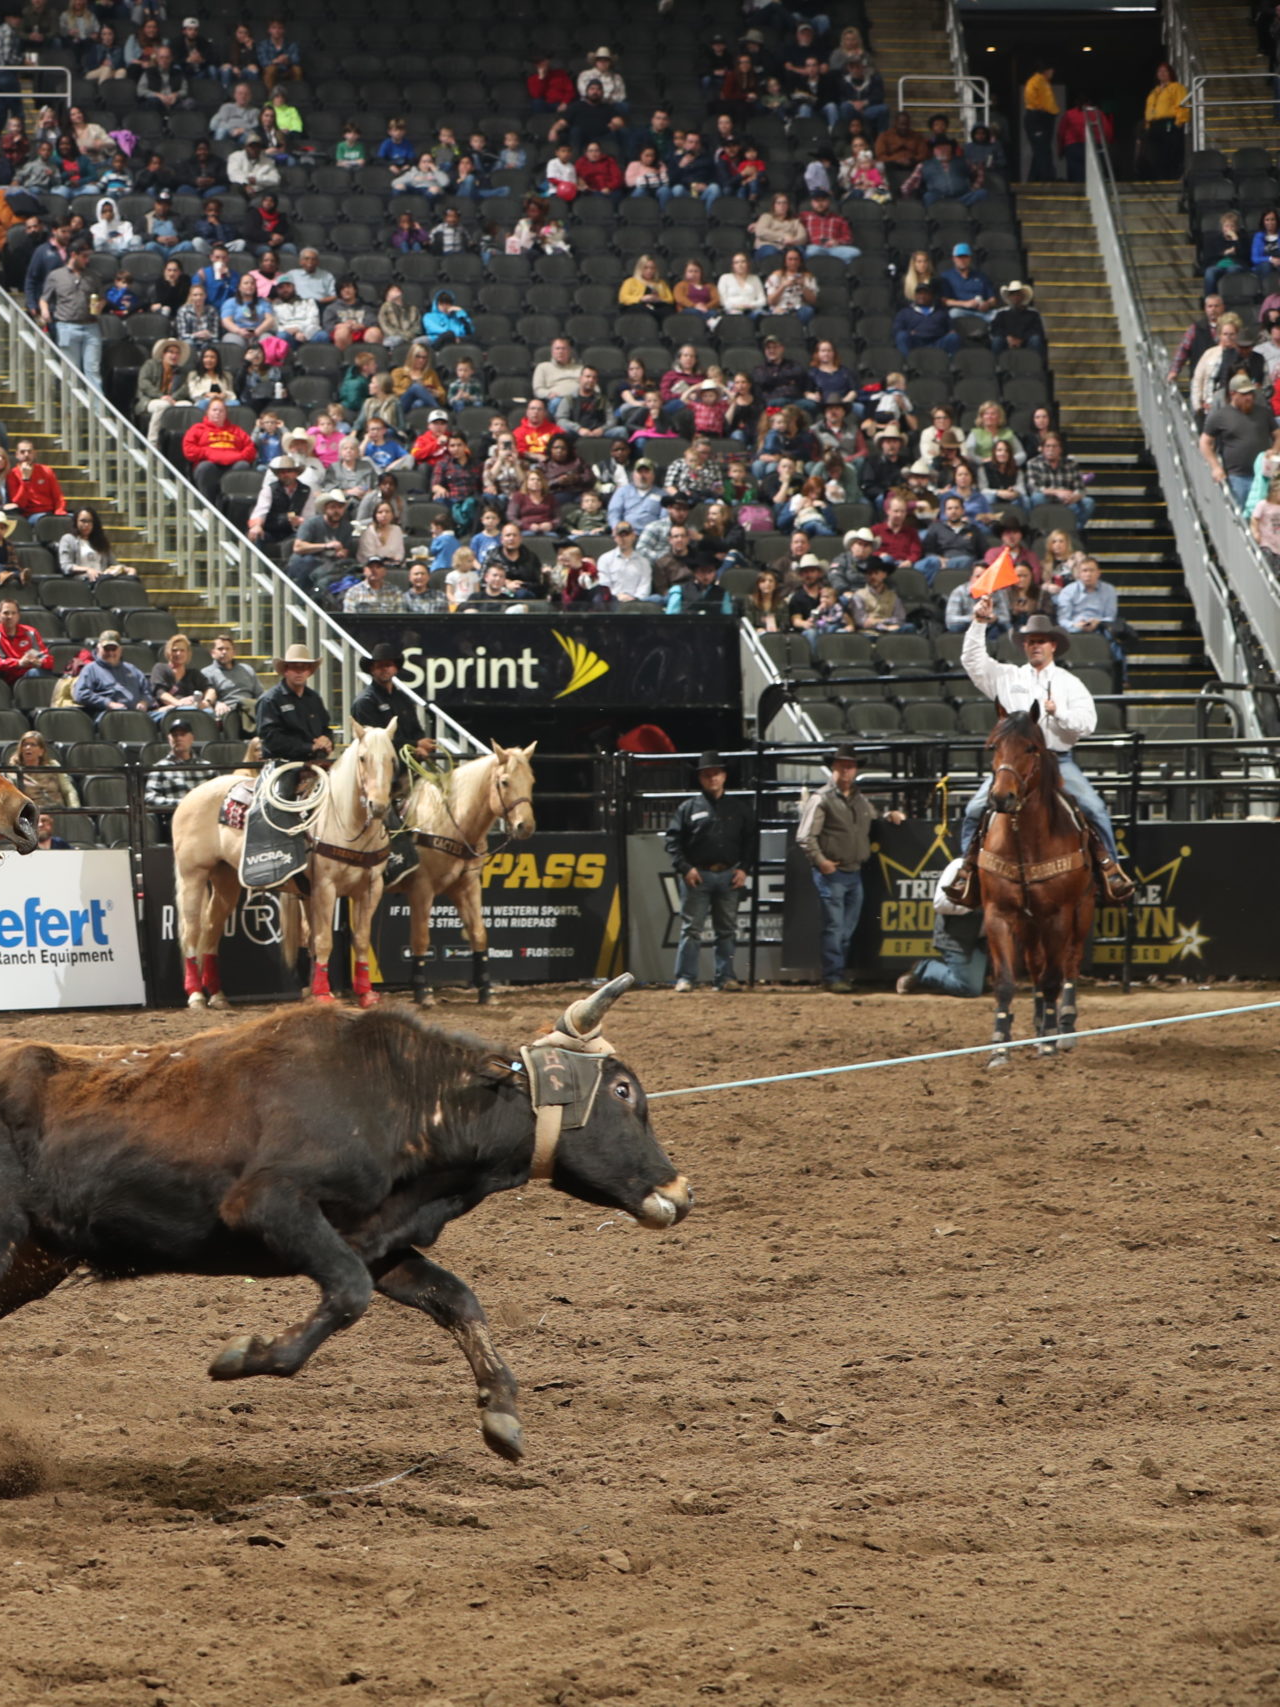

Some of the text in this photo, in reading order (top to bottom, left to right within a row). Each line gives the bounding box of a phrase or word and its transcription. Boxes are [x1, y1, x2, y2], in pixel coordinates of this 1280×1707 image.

[399, 646, 539, 700] Sprint
[246, 850, 285, 865] WCRA
[896, 880, 936, 899] TRI
[493, 906, 539, 916] WESTERN
[541, 906, 582, 918] SPORTS,
[881, 901, 935, 931] CRO
[494, 918, 509, 928] ON
[510, 918, 558, 928] RIDEPASS
[41, 949, 114, 967] Equipment
